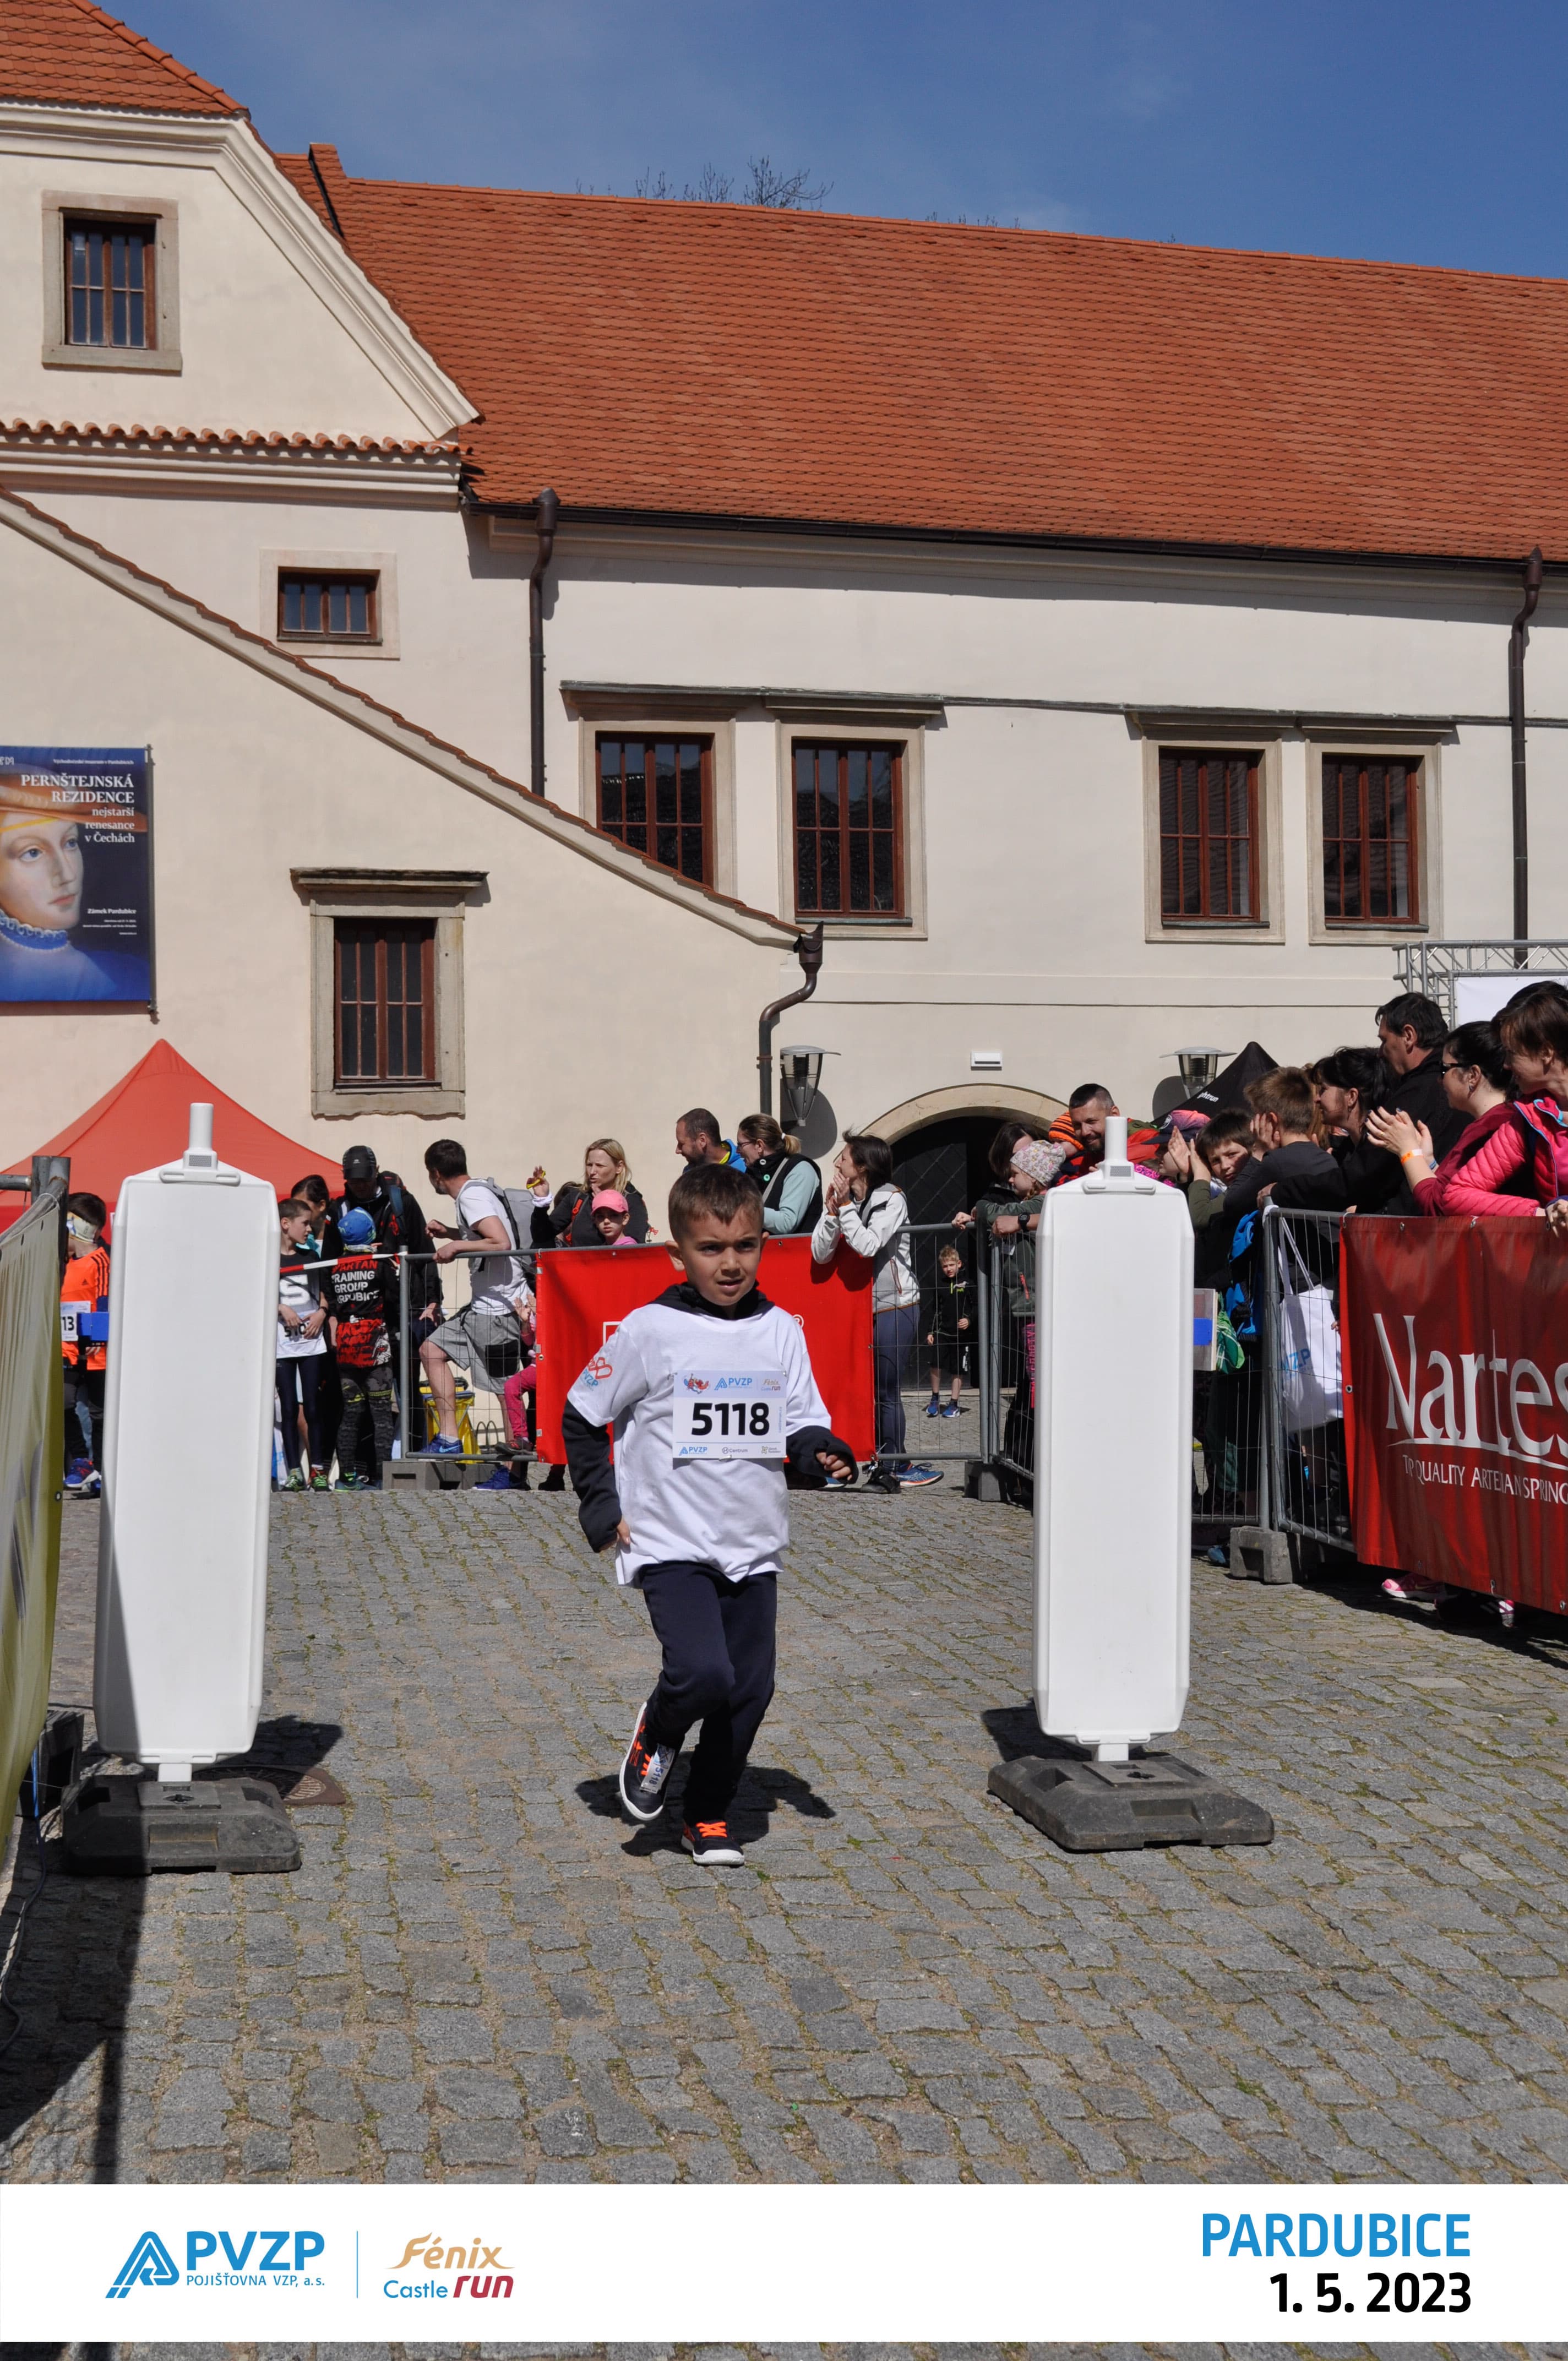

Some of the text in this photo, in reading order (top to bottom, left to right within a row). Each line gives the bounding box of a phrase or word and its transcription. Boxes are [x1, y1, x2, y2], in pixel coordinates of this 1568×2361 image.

[21, 773, 134, 787] PERNŠTEJNSKÁ
[52, 791, 134, 803] REZIDENCE
[92, 807, 134, 818] nejstarší
[93, 831, 135, 843] Čechách
[334, 1281, 368, 1293] GROUP
[728, 1378, 753, 1386] PVZP
[691, 1402, 770, 1436] 5118
[1415, 1461, 1465, 1486] QUALITY
